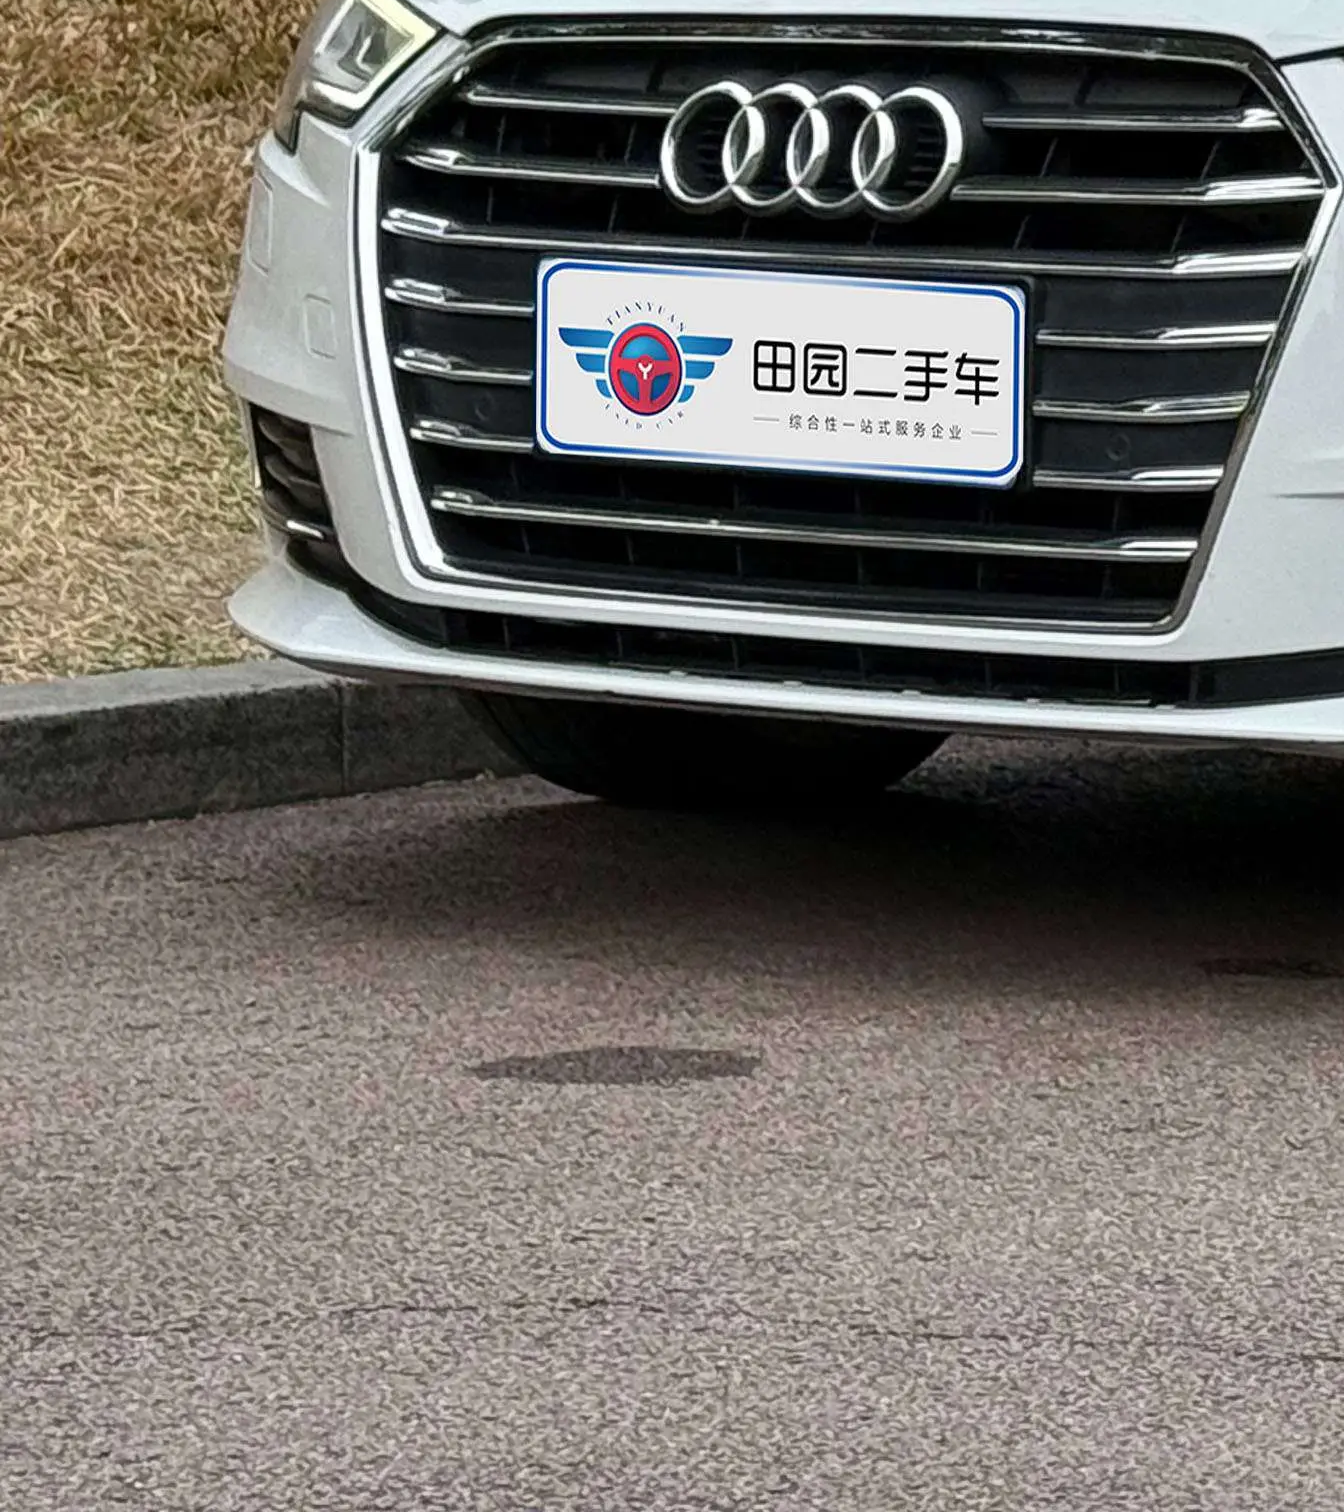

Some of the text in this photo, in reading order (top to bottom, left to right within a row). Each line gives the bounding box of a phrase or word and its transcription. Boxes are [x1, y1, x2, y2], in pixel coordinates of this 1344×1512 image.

[752, 339, 1001, 407] 田园二手车
[788, 412, 963, 441] 综合性一站式服务企业
